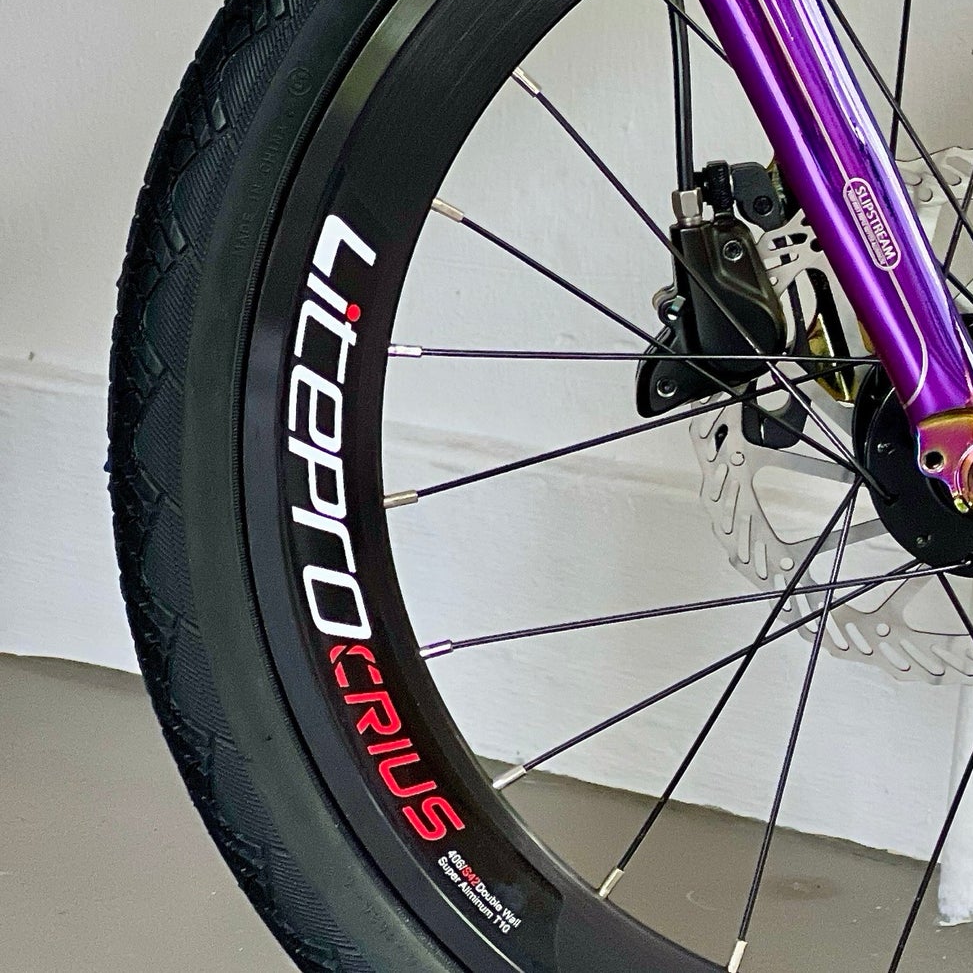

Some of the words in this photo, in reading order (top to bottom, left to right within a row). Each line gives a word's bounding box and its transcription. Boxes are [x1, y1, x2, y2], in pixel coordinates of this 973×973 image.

[854, 185, 897, 261] SLIPSTREAM
[329, 644, 466, 842] CRIUS
[437, 855, 462, 884] Super
[492, 914, 512, 935] T10
[501, 907, 522, 929] Wall
